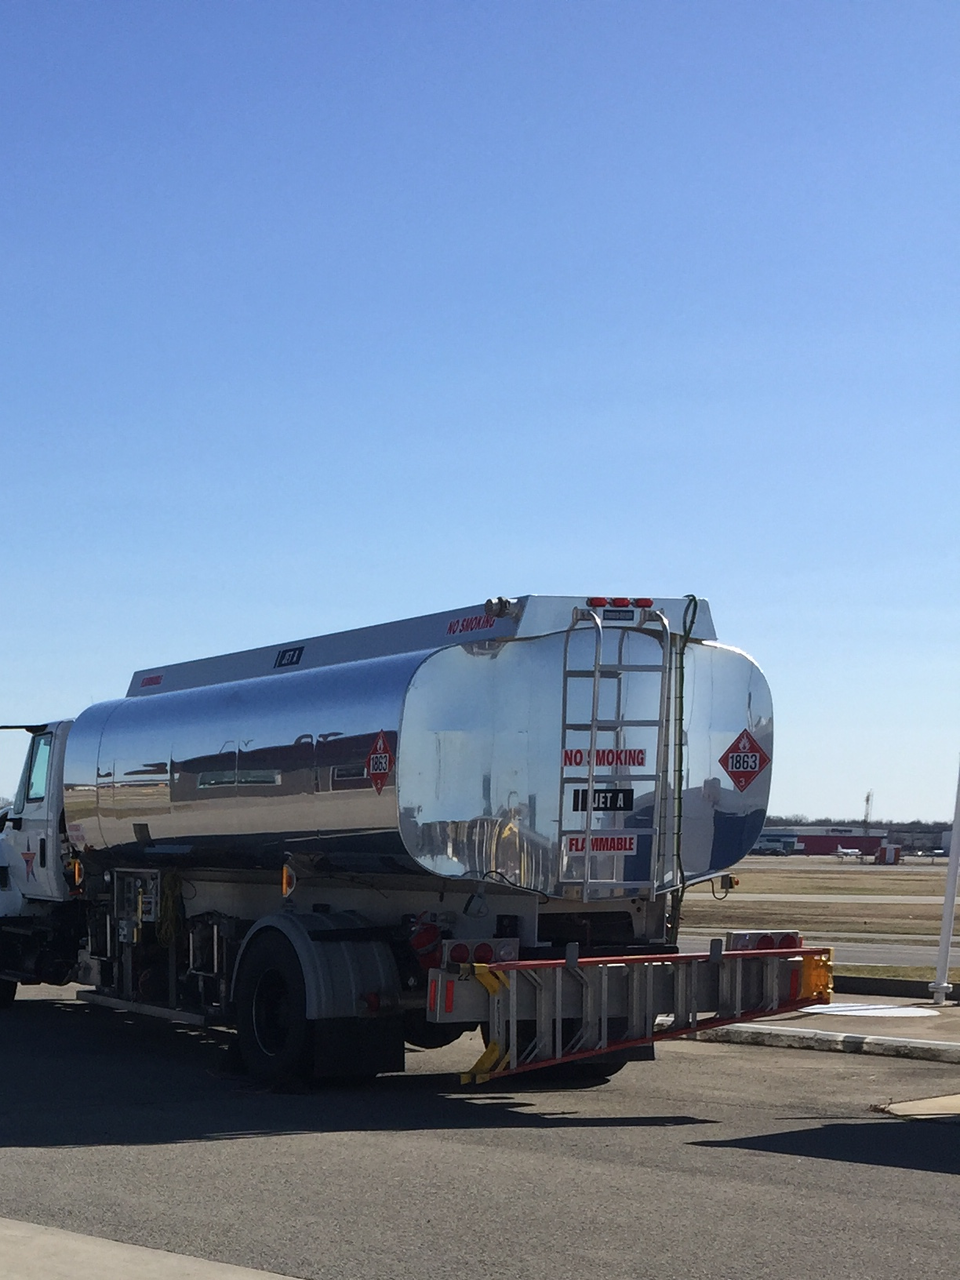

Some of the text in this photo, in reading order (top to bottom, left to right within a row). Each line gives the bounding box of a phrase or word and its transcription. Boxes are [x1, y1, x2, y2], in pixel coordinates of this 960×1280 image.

[446, 614, 496, 635] NO SMOKING
[371, 755, 388, 772] 1863
[563, 749, 584, 766] NO
[730, 754, 757, 770] 1863
[740, 778, 745, 786] 3
[592, 793, 624, 808] JET A
[569, 837, 634, 852] FLAMMABLE
